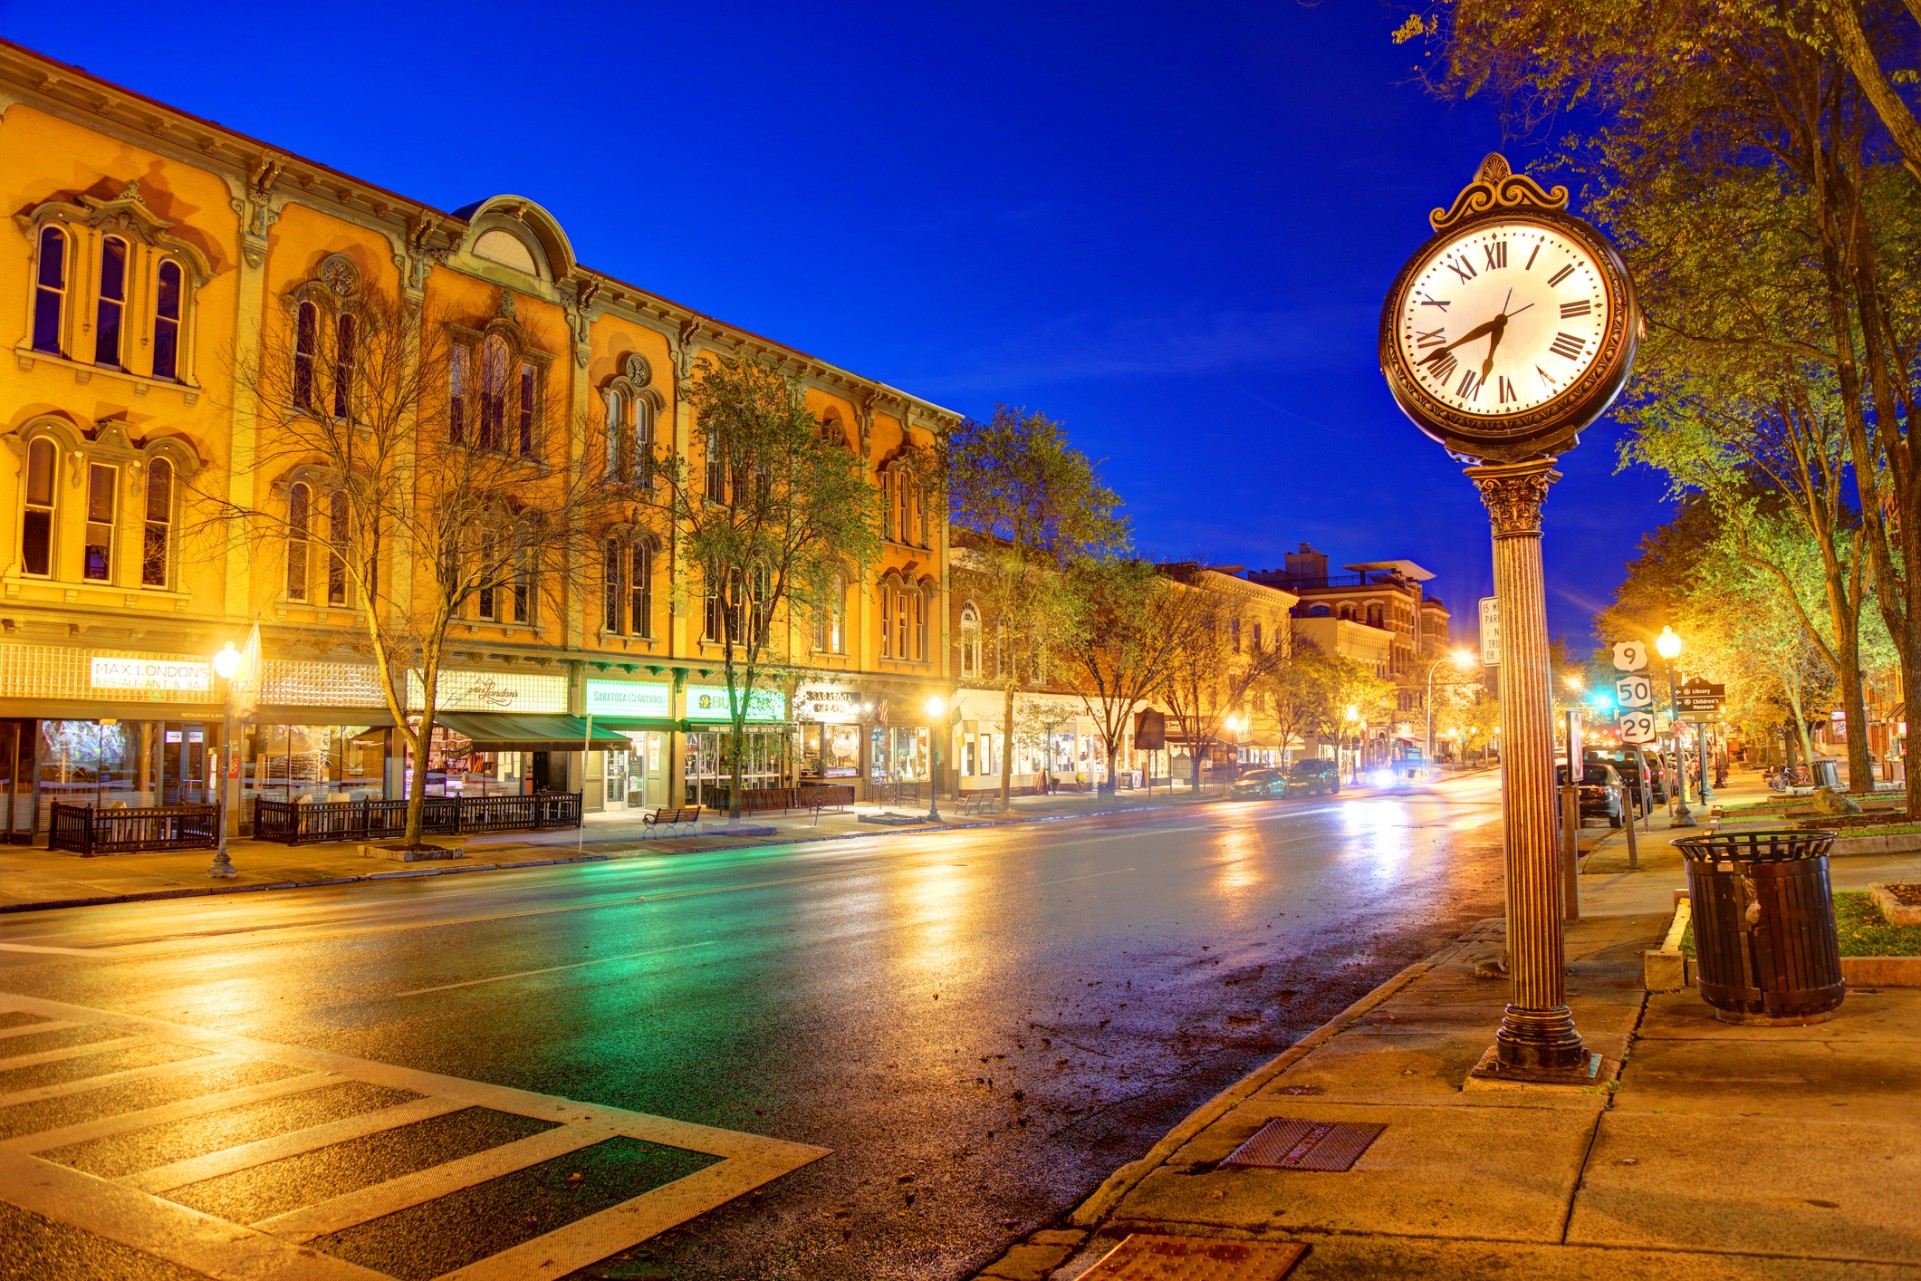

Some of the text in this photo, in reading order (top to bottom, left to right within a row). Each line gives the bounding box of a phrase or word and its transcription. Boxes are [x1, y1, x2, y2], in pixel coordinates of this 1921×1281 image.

[1484, 241, 1507, 271] XII
[1447, 254, 1477, 285] XI
[1547, 263, 1576, 287] II
[1421, 293, 1451, 313] X
[1560, 300, 1591, 319] III
[1416, 327, 1446, 348] IX
[1535, 364, 1556, 387] V
[1499, 375, 1517, 403] VI
[1483, 604, 1489, 613] 15
[1486, 651, 1495, 660] OR
[1624, 648, 1636, 665] 9
[95, 663, 209, 679] MAX LONDON'S
[593, 690, 663, 704] SARATOGA CoWorks
[1620, 683, 1648, 701] 50
[1623, 718, 1651, 737] 29
